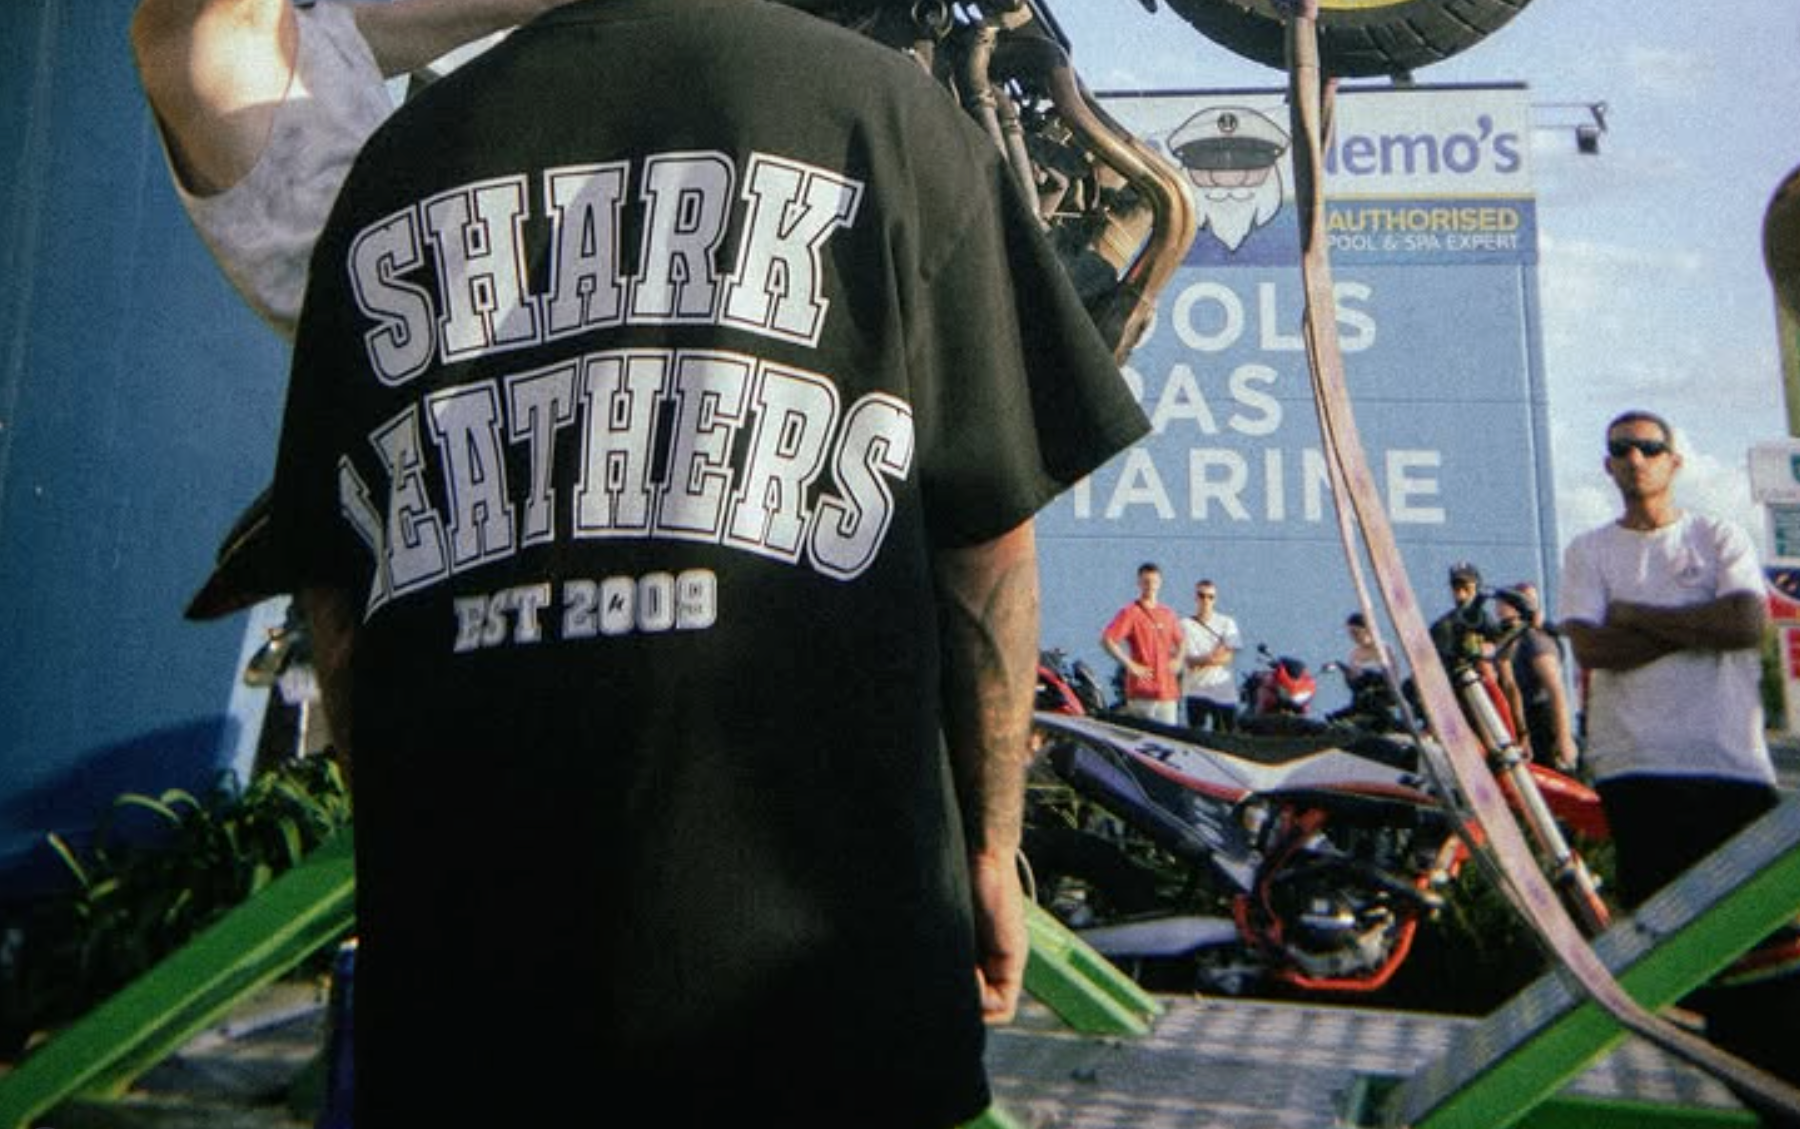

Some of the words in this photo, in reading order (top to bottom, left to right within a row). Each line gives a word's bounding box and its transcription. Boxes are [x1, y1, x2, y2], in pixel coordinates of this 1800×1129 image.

[1328, 207, 1519, 232] AUTHORISED
[1383, 235, 1398, 251] &
[1404, 234, 1441, 251] SPA
[1449, 234, 1518, 251] EXPERT
[347, 149, 865, 387] SHARK
[1130, 281, 1377, 353] OLS
[452, 582, 551, 654] EST
[561, 568, 718, 640] 2009
